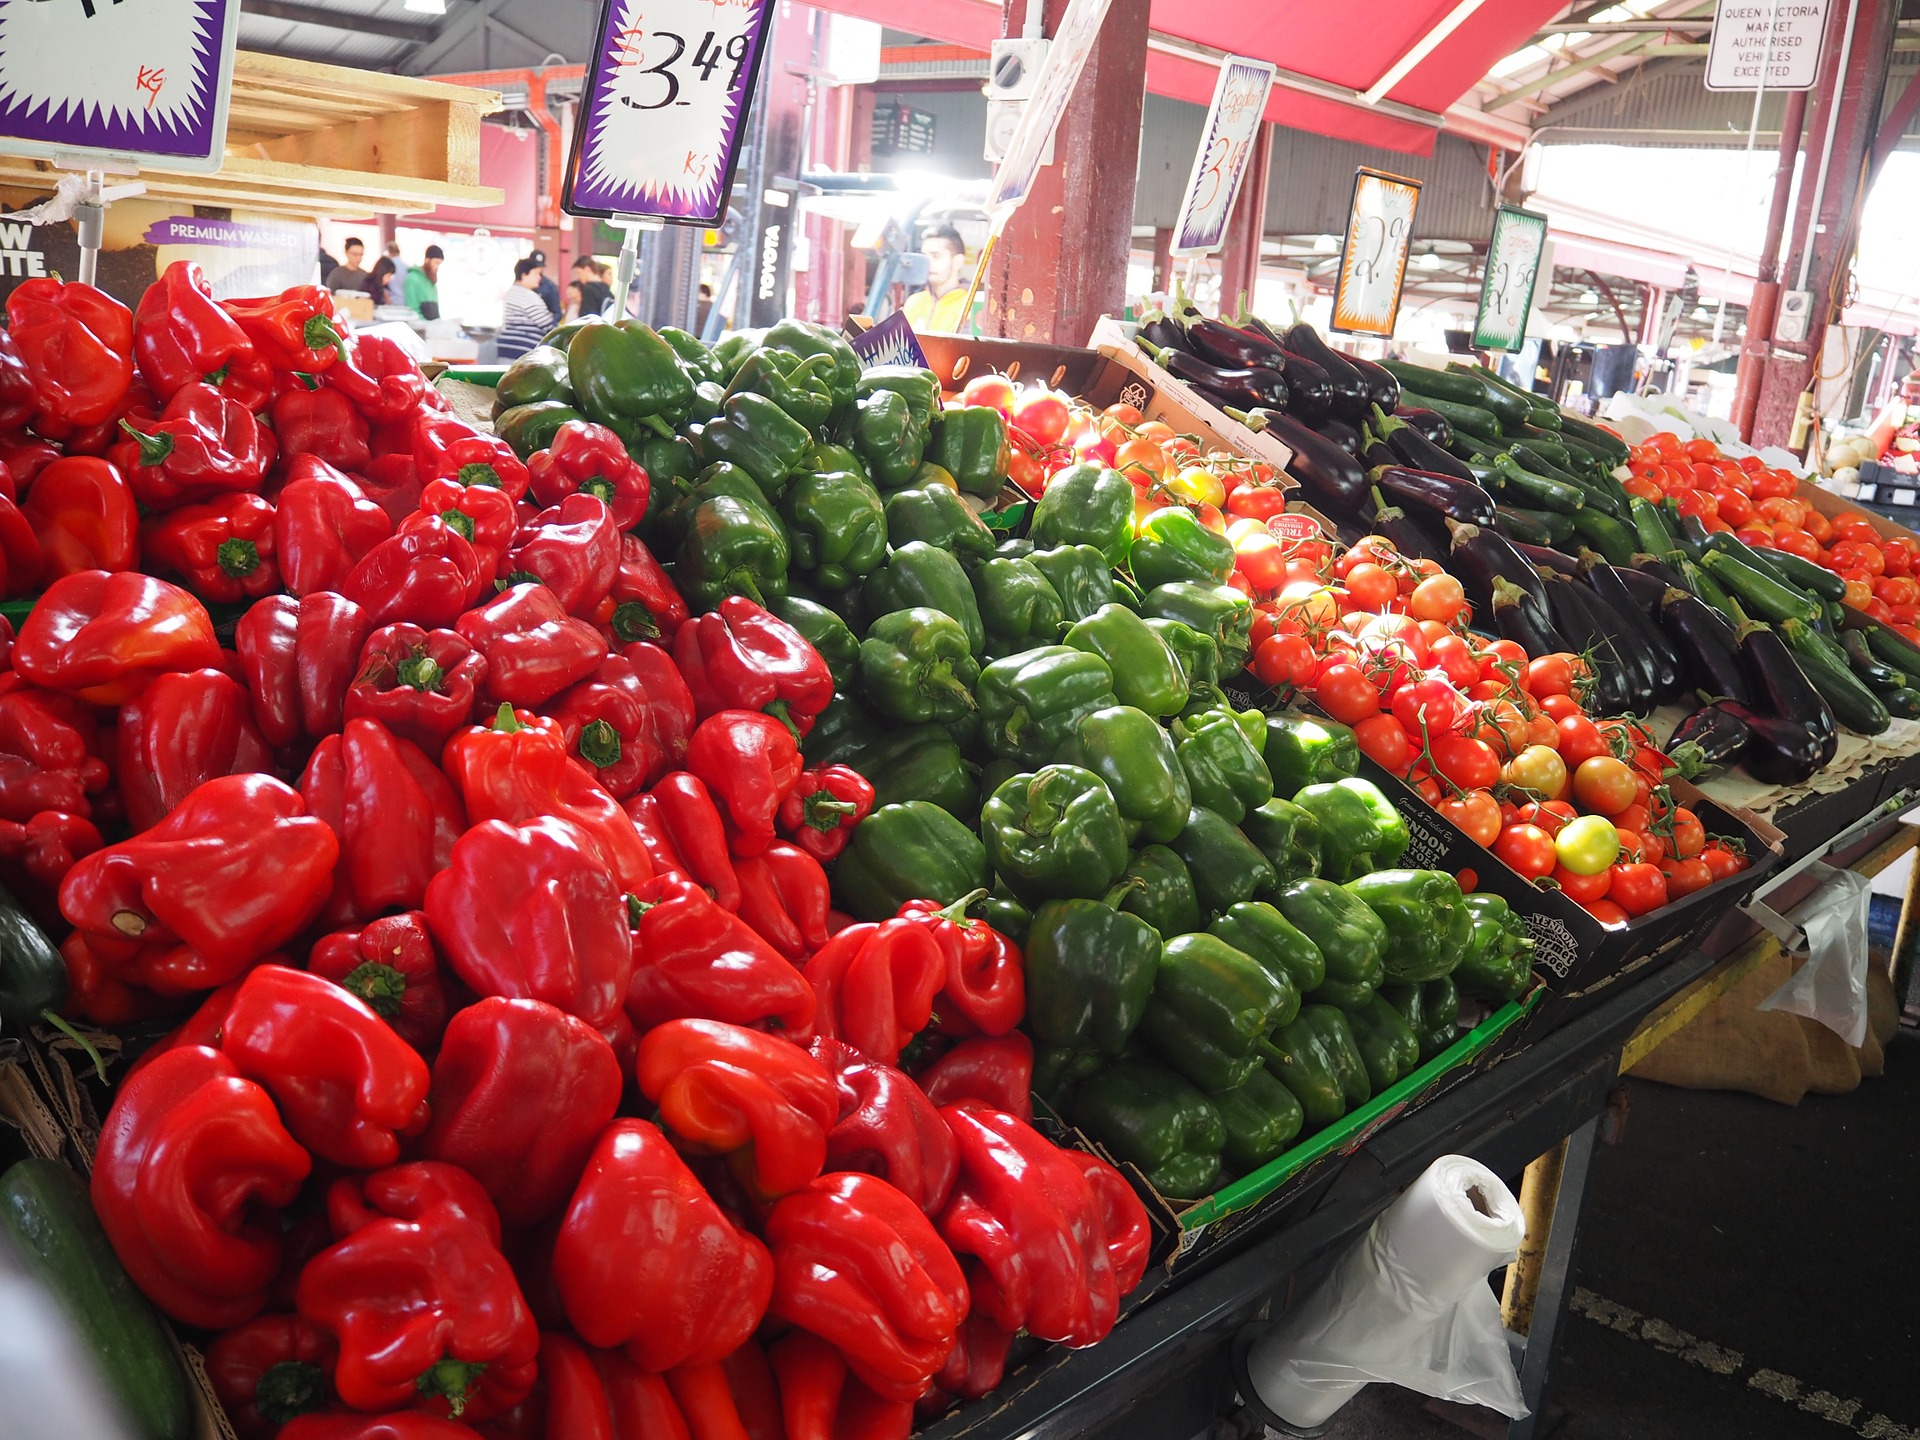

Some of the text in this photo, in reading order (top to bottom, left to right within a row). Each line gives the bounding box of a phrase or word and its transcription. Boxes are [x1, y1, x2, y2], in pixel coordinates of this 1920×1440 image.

[1725, 8, 1762, 19] QUEEN
[1738, 52, 1791, 62] VEHILES
[1733, 66, 1790, 77] EXCETED
[170, 223, 298, 247] PREMIUM WASHED
[759, 225, 780, 299] TOYOTA
[1226, 687, 1255, 710] YENDO
[1535, 914, 1576, 949] YENDON
[1535, 949, 1569, 977] atoes
